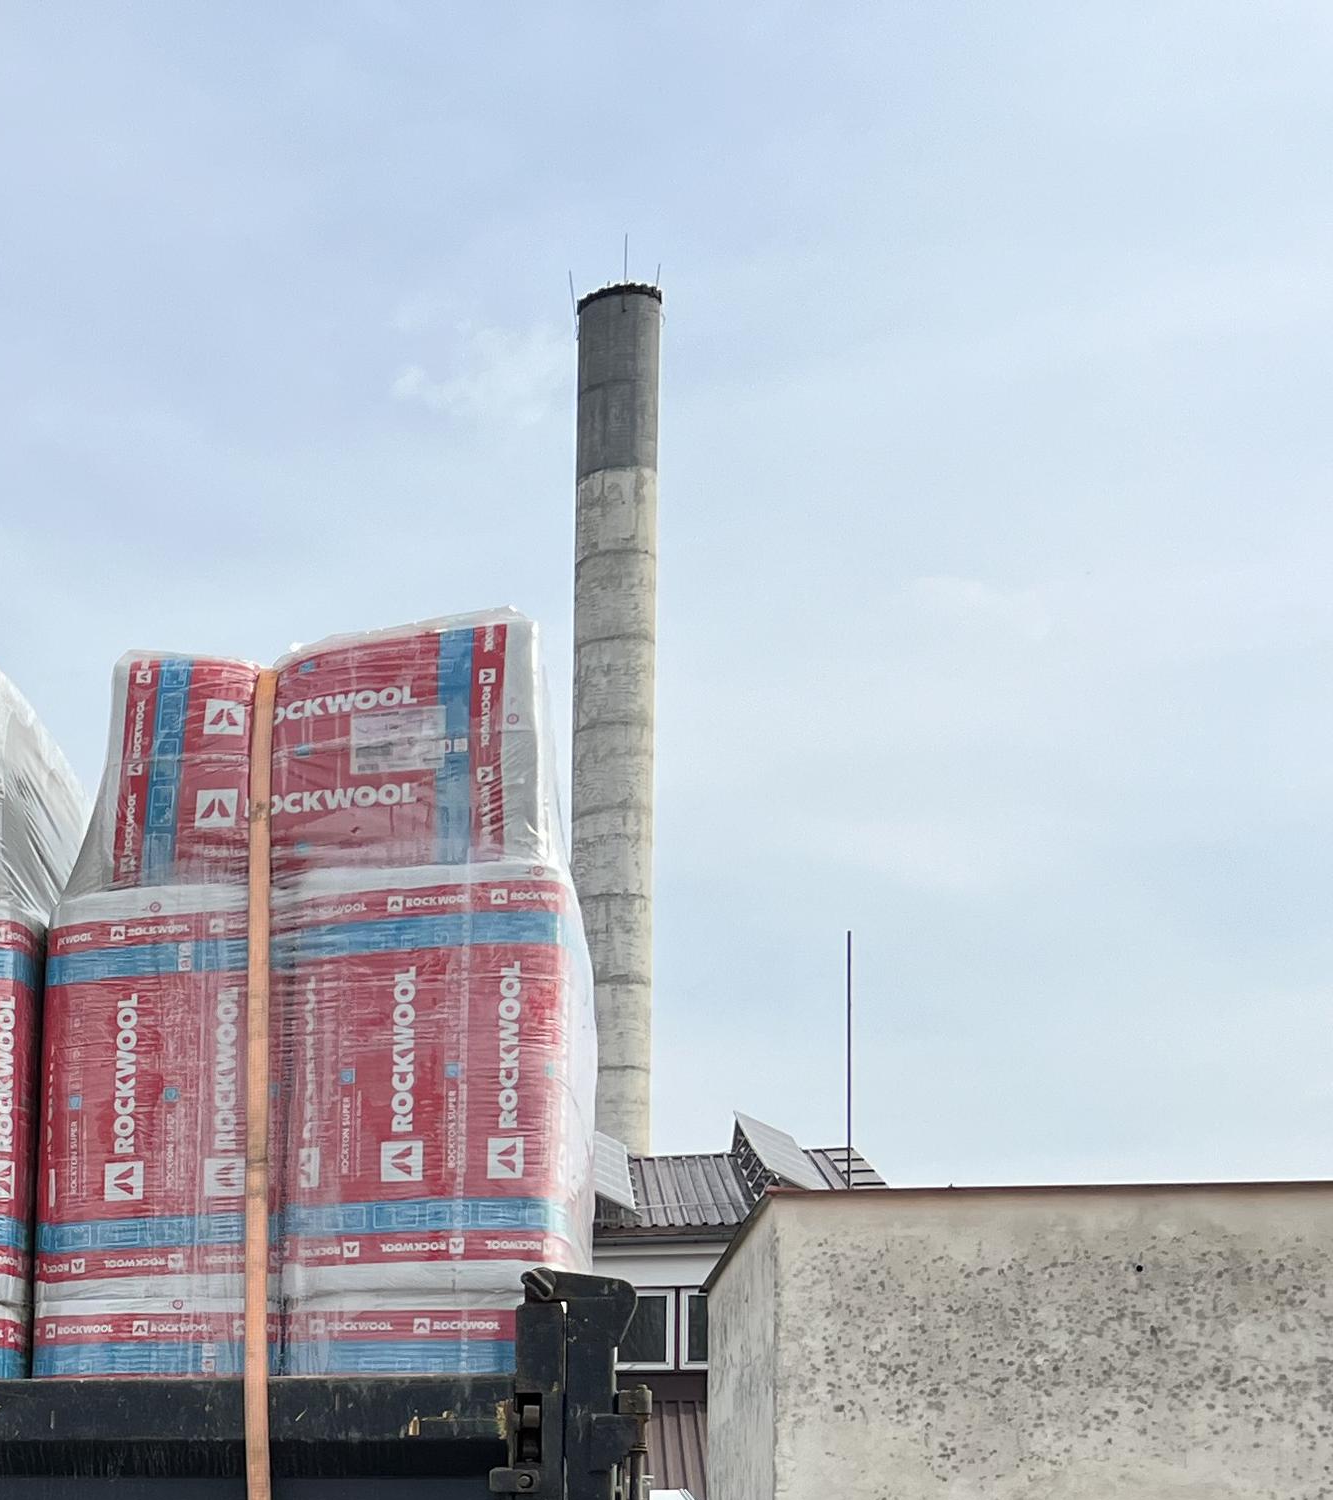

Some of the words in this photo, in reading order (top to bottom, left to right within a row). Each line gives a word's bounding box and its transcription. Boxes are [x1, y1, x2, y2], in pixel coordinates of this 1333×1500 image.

[405, 893, 469, 907] ROCKWOOL
[391, 966, 416, 1132] ROCKWOOL
[498, 960, 521, 1128] ROCKWOOL
[113, 993, 138, 1155] ROCKWOOL
[381, 1241, 446, 1253] ROCKWOOL
[485, 1240, 541, 1250] ROCKWOOL
[104, 1257, 166, 1268] ROCKWOOL
[57, 1324, 113, 1335] ROCKWOOL
[433, 1320, 500, 1331] ROCKWOOL
